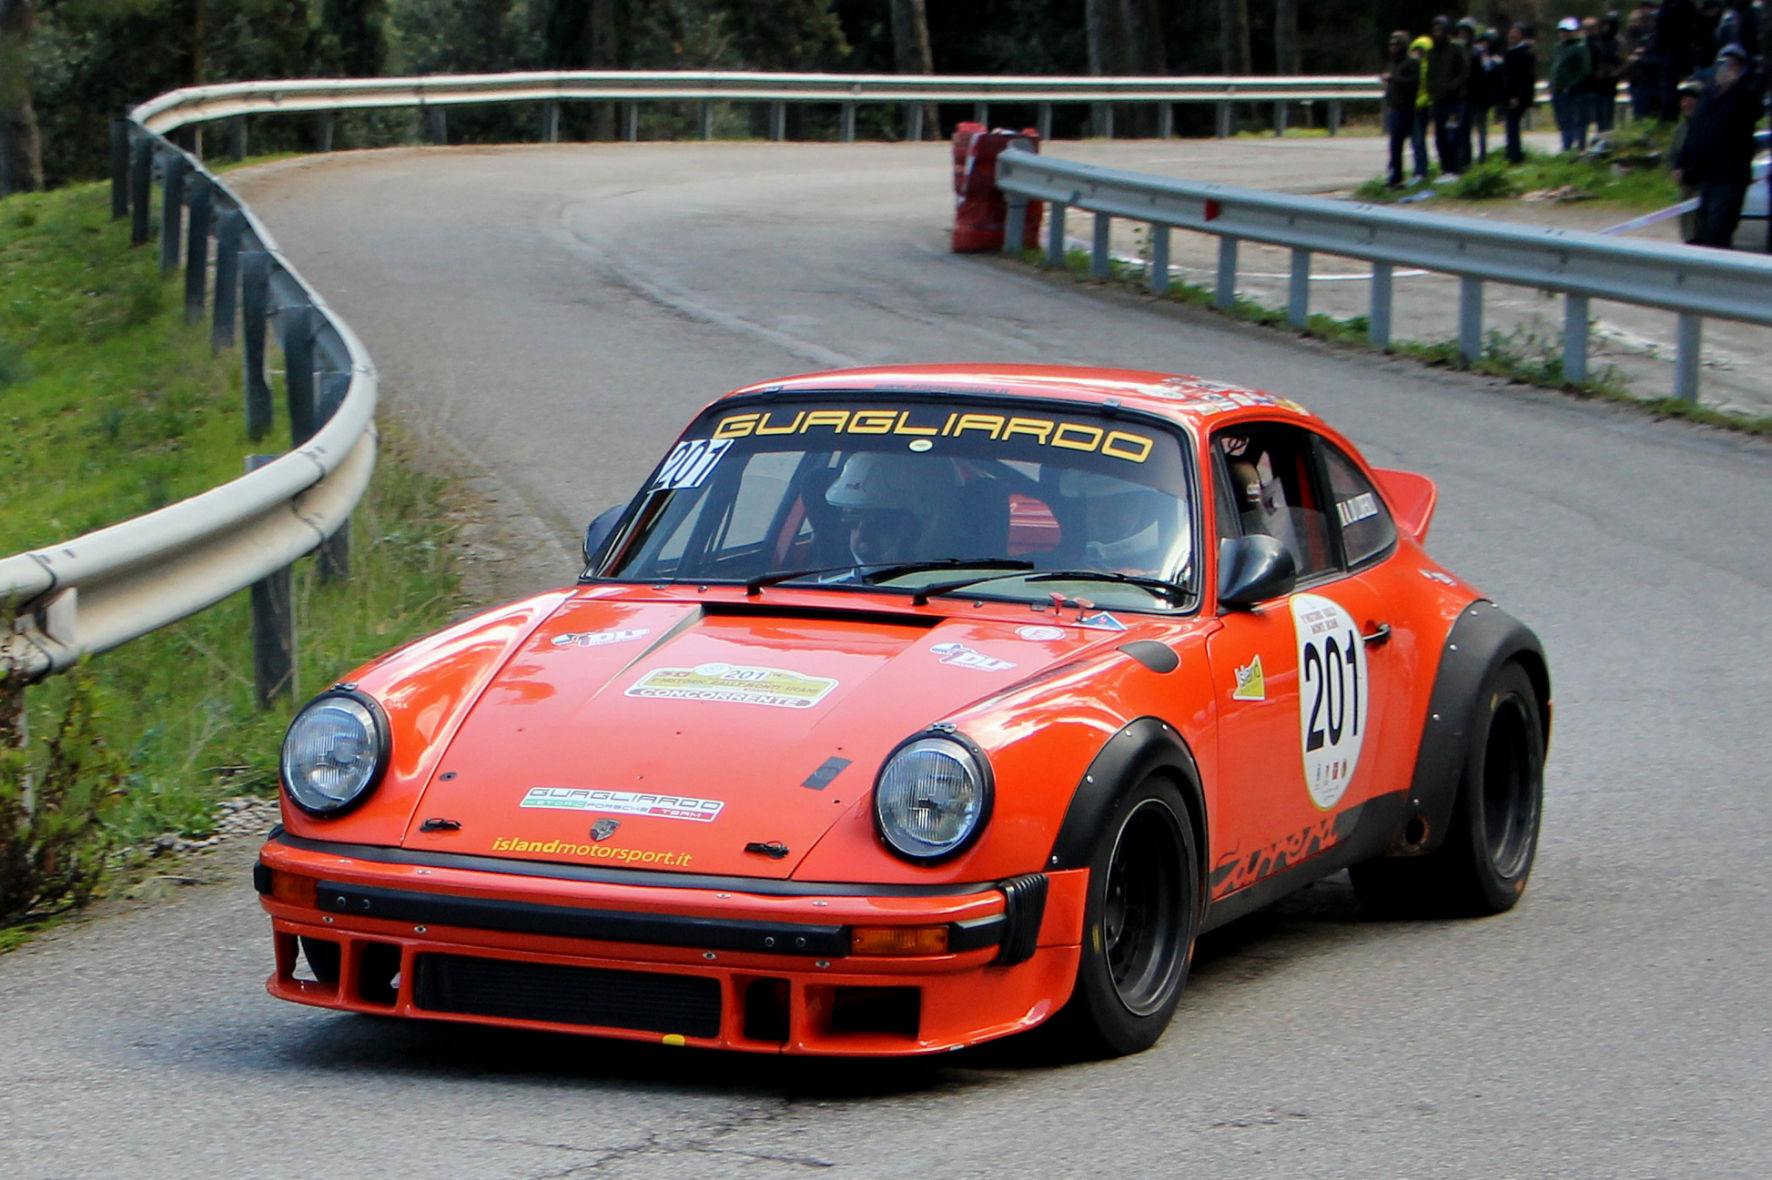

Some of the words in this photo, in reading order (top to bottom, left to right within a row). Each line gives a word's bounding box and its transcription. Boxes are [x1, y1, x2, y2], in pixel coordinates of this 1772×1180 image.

[712, 409, 1154, 463] GUAGLIARDO
[656, 439, 732, 489] 201
[724, 670, 767, 680] 201
[1303, 629, 1358, 753] 201
[639, 688, 800, 706] CONCORRENTE
[528, 788, 721, 810] GUAGLIARDO
[587, 802, 649, 812] PORSCHE
[662, 809, 703, 818] TEAM
[491, 836, 693, 868] islandmotorsport.it
[1211, 818, 1340, 900] Carrera
